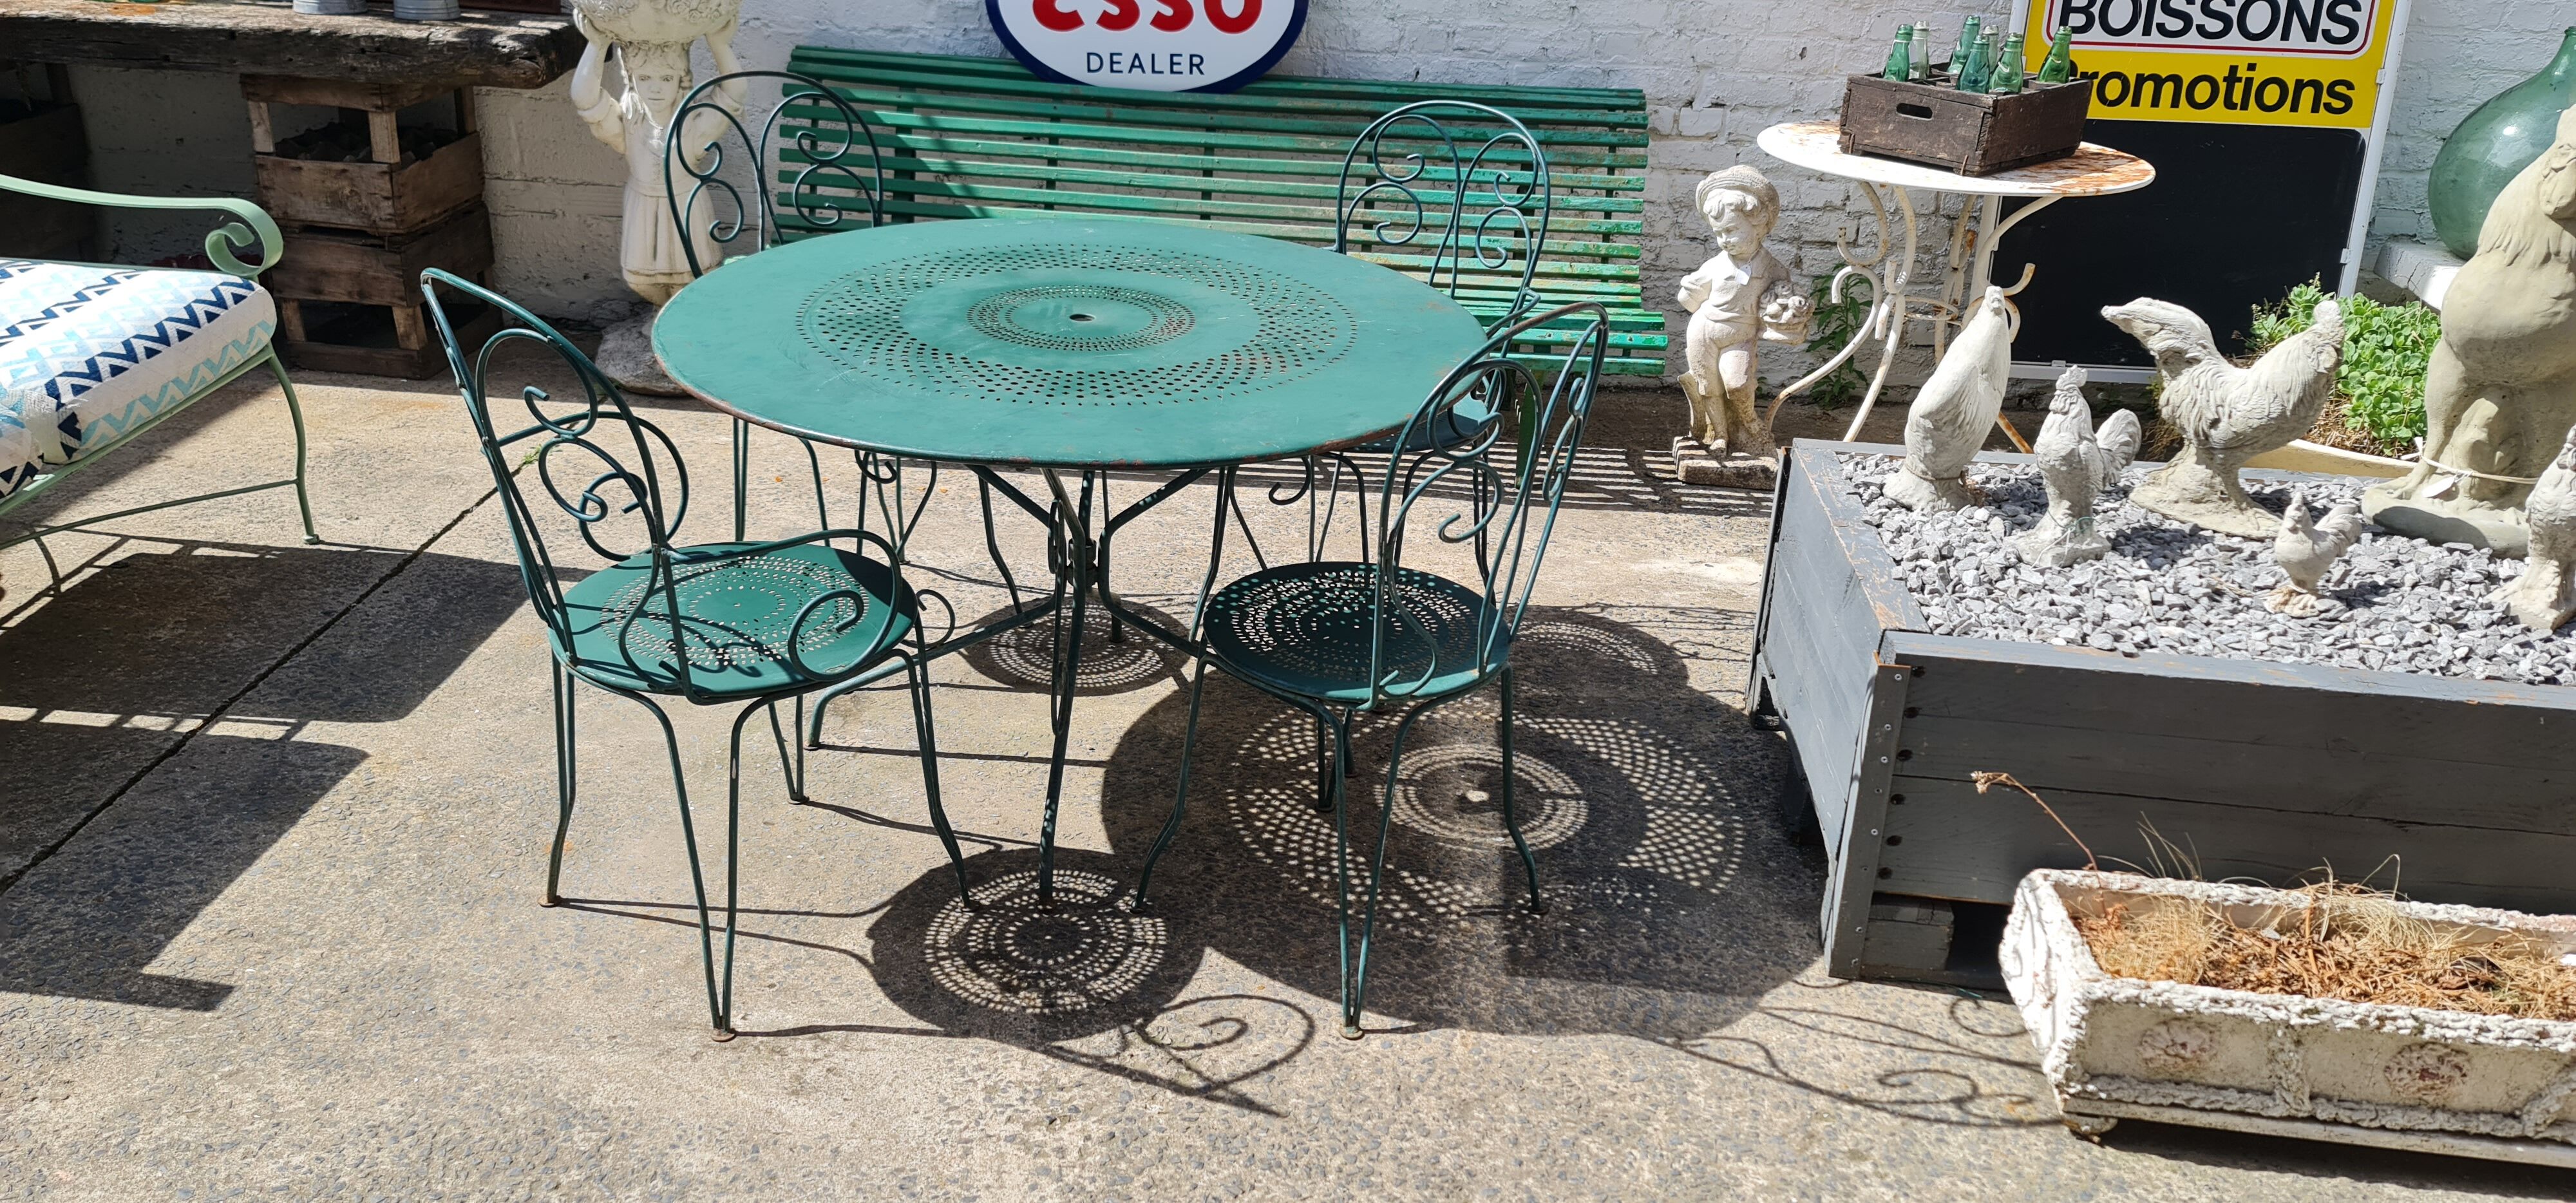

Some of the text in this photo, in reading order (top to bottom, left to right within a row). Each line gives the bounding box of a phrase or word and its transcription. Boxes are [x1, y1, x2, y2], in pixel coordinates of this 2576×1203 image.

[2059, 0, 2362, 44] BOISSONS
[1086, 52, 1205, 75] DEALER
[2069, 59, 2355, 115] omotions
